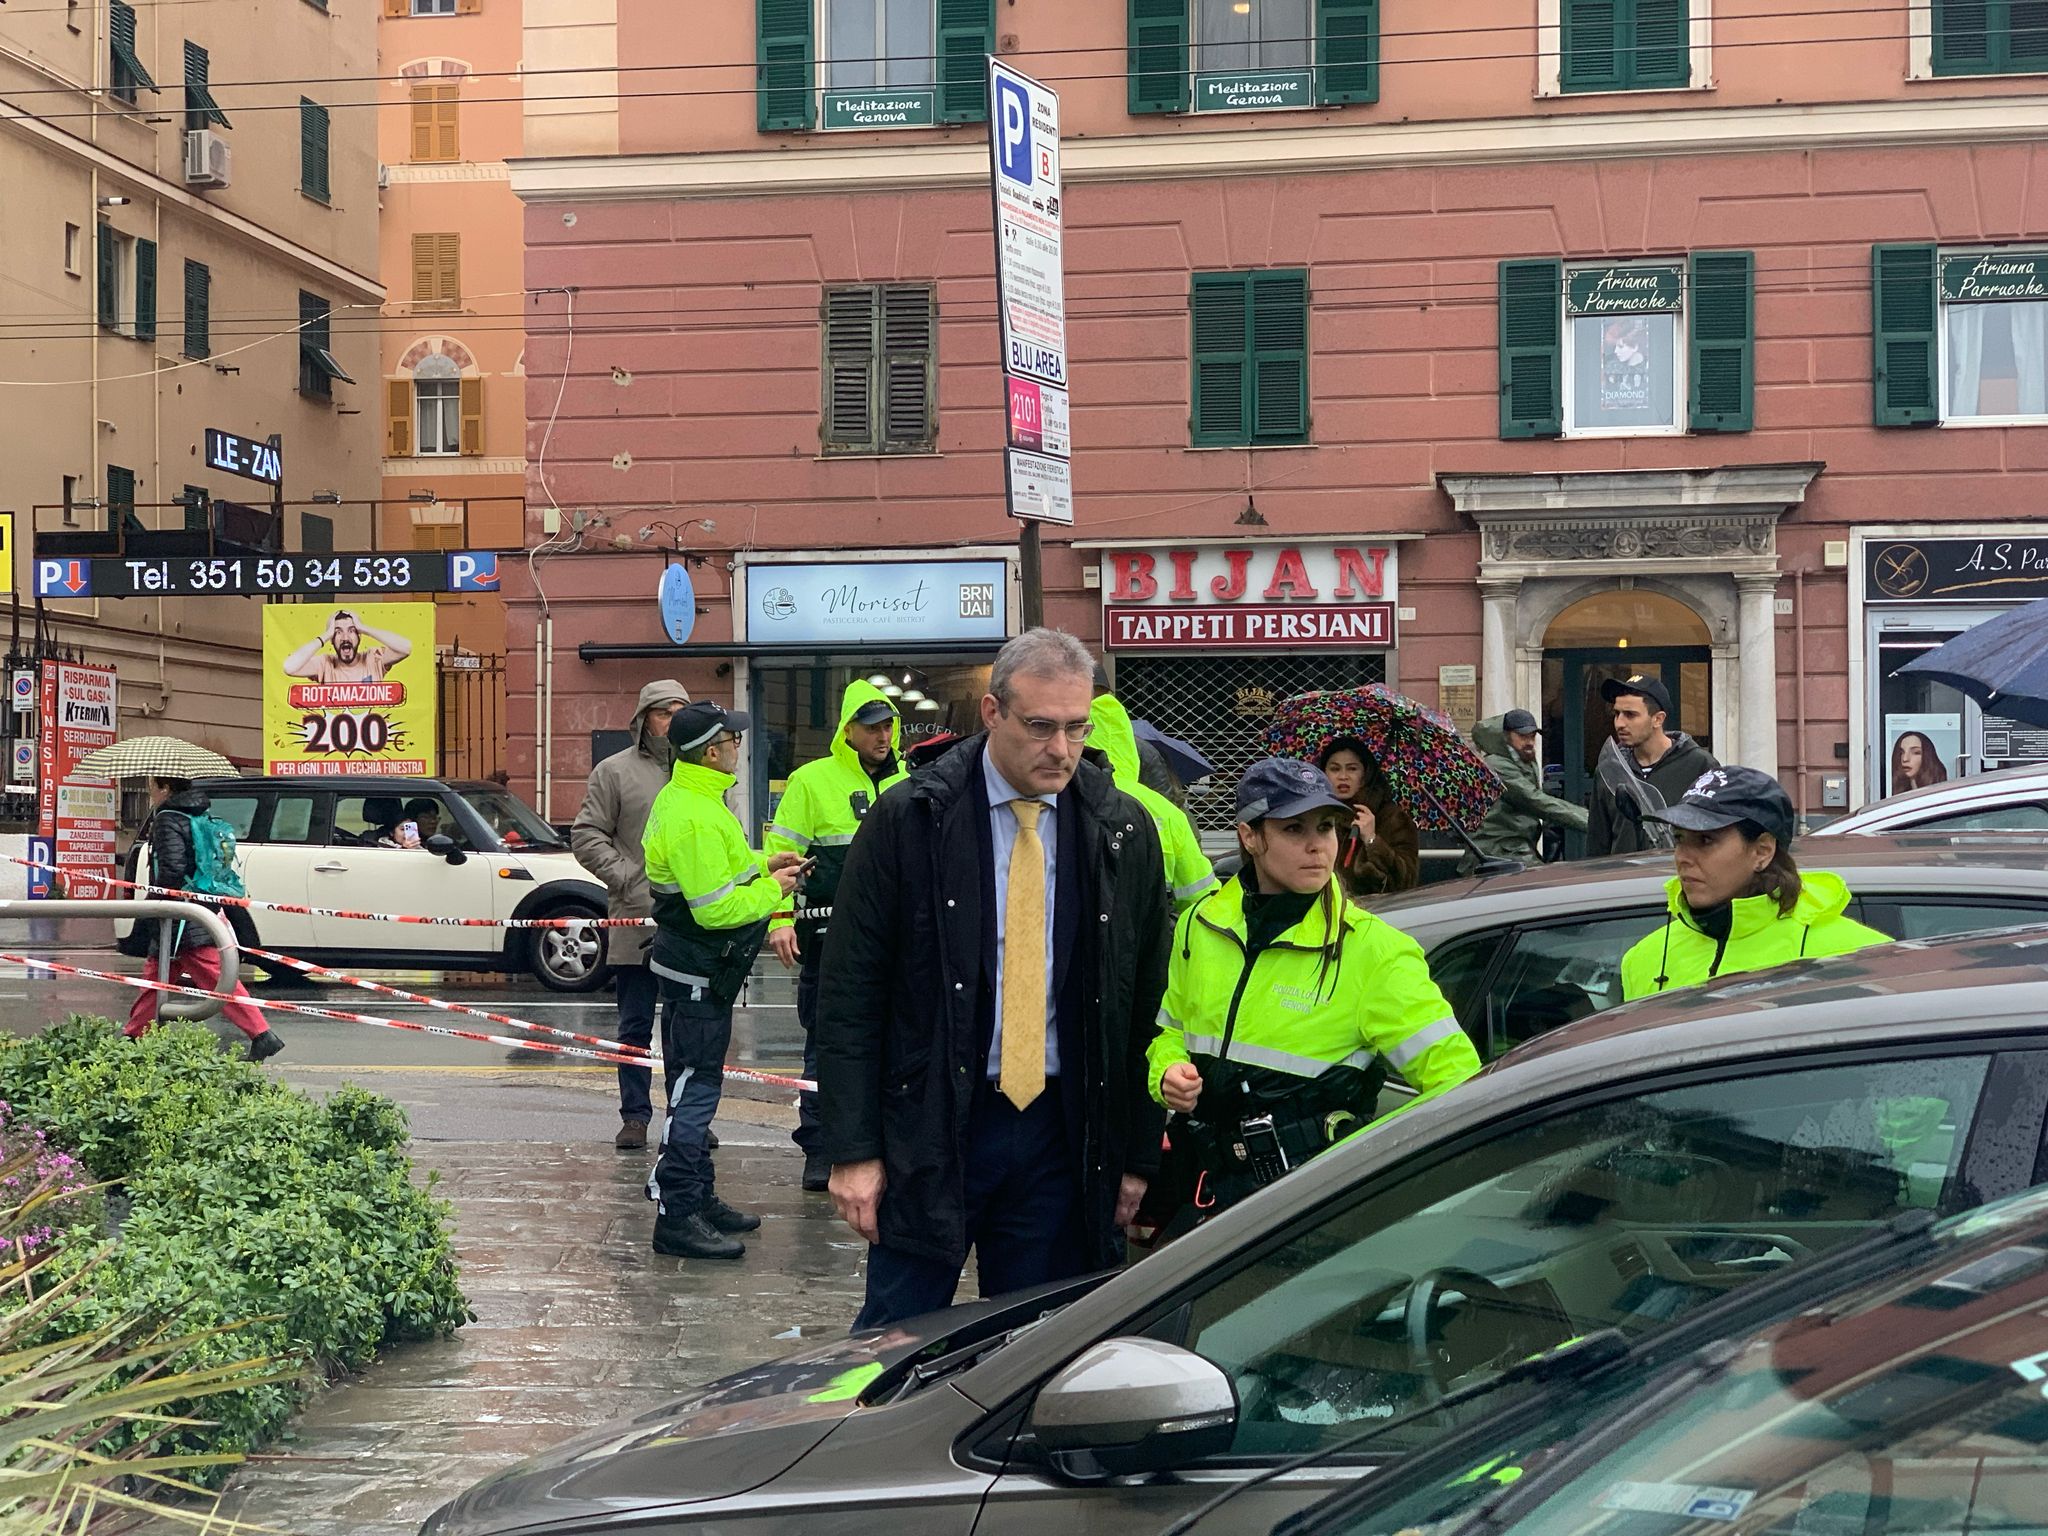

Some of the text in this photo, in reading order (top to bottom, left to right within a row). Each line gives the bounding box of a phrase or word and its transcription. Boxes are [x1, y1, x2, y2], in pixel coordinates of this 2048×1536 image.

[1208, 82, 1298, 95] Meditazione
[836, 100, 921, 112] Meditazione
[1226, 94, 1283, 105] Genova
[853, 112, 907, 122] Genova
[1037, 102, 1051, 117] ZONA
[1002, 87, 1024, 168] P
[1032, 117, 1057, 137] RESIDENTI
[1042, 152, 1049, 176] B
[1972, 255, 2035, 276] Arianna
[1597, 269, 1657, 290] Arianna
[1958, 275, 2044, 298] Parrucche
[1584, 290, 1666, 311] Parrucche
[1012, 341, 1062, 379] BLU AREA
[1605, 390, 1645, 399] DIAMOND
[1013, 392, 1036, 424] 2101
[1955, 543, 1985, 571] A.
[1990, 543, 2012, 570] S.
[40, 561, 62, 593] P
[126, 558, 411, 590] Tel. 351 50 34 533
[453, 555, 476, 588] P
[1109, 548, 1390, 601] BIJAN
[821, 579, 930, 614] Morisot
[960, 586, 993, 600] BRN
[960, 602, 987, 616] UAI
[822, 616, 868, 624] PASTICCERIA
[1118, 613, 1382, 640] TAPPETI PERSIANI
[64, 670, 111, 688] RISPARMIA
[69, 687, 106, 702] SUL GAS!
[302, 685, 392, 702] ROTTAMAZIONE
[64, 730, 112, 746] SERRAMENTI
[302, 713, 388, 753] 200
[43, 683, 54, 807] FINESTRE
[277, 761, 423, 775] PER OGNI TUA VECCHIA FINESTRA
[74, 820, 102, 830] PERSIANE
[69, 831, 104, 840] ZANZARIERE
[69, 842, 104, 851] TAPPARELLE
[82, 855, 110, 863] BLINDATE
[73, 885, 99, 898] LIBERO
[1281, 998, 1311, 1015] GENOVA
